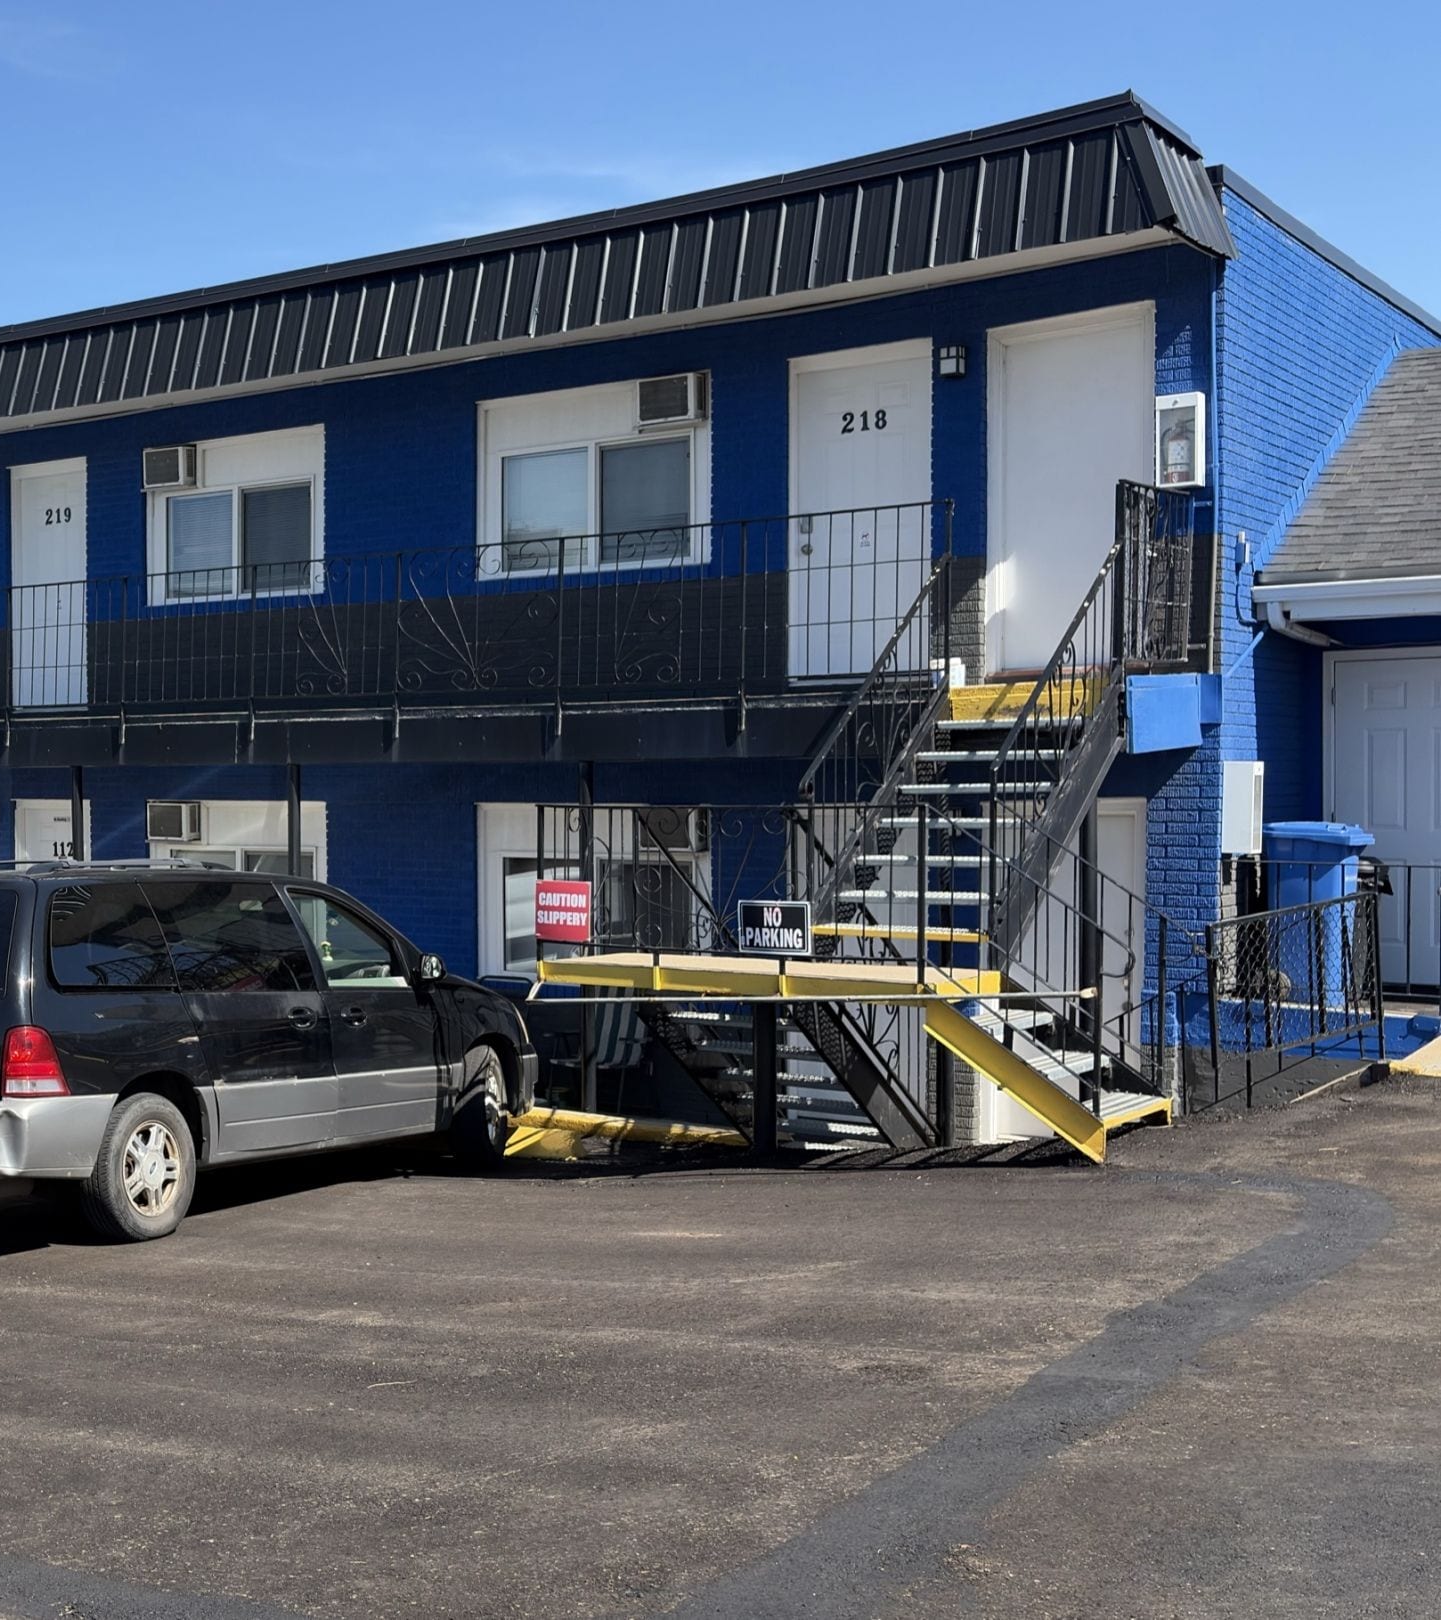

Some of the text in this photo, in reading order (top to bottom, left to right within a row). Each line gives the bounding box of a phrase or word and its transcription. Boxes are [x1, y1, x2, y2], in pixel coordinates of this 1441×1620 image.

[841, 409, 888, 435] 218
[45, 507, 72, 526] 219
[52, 842, 74, 857] 112
[538, 892, 587, 908] CAUTION
[536, 909, 588, 926] SLIPPERY
[763, 906, 783, 926] NO
[745, 927, 804, 949] PARKING
